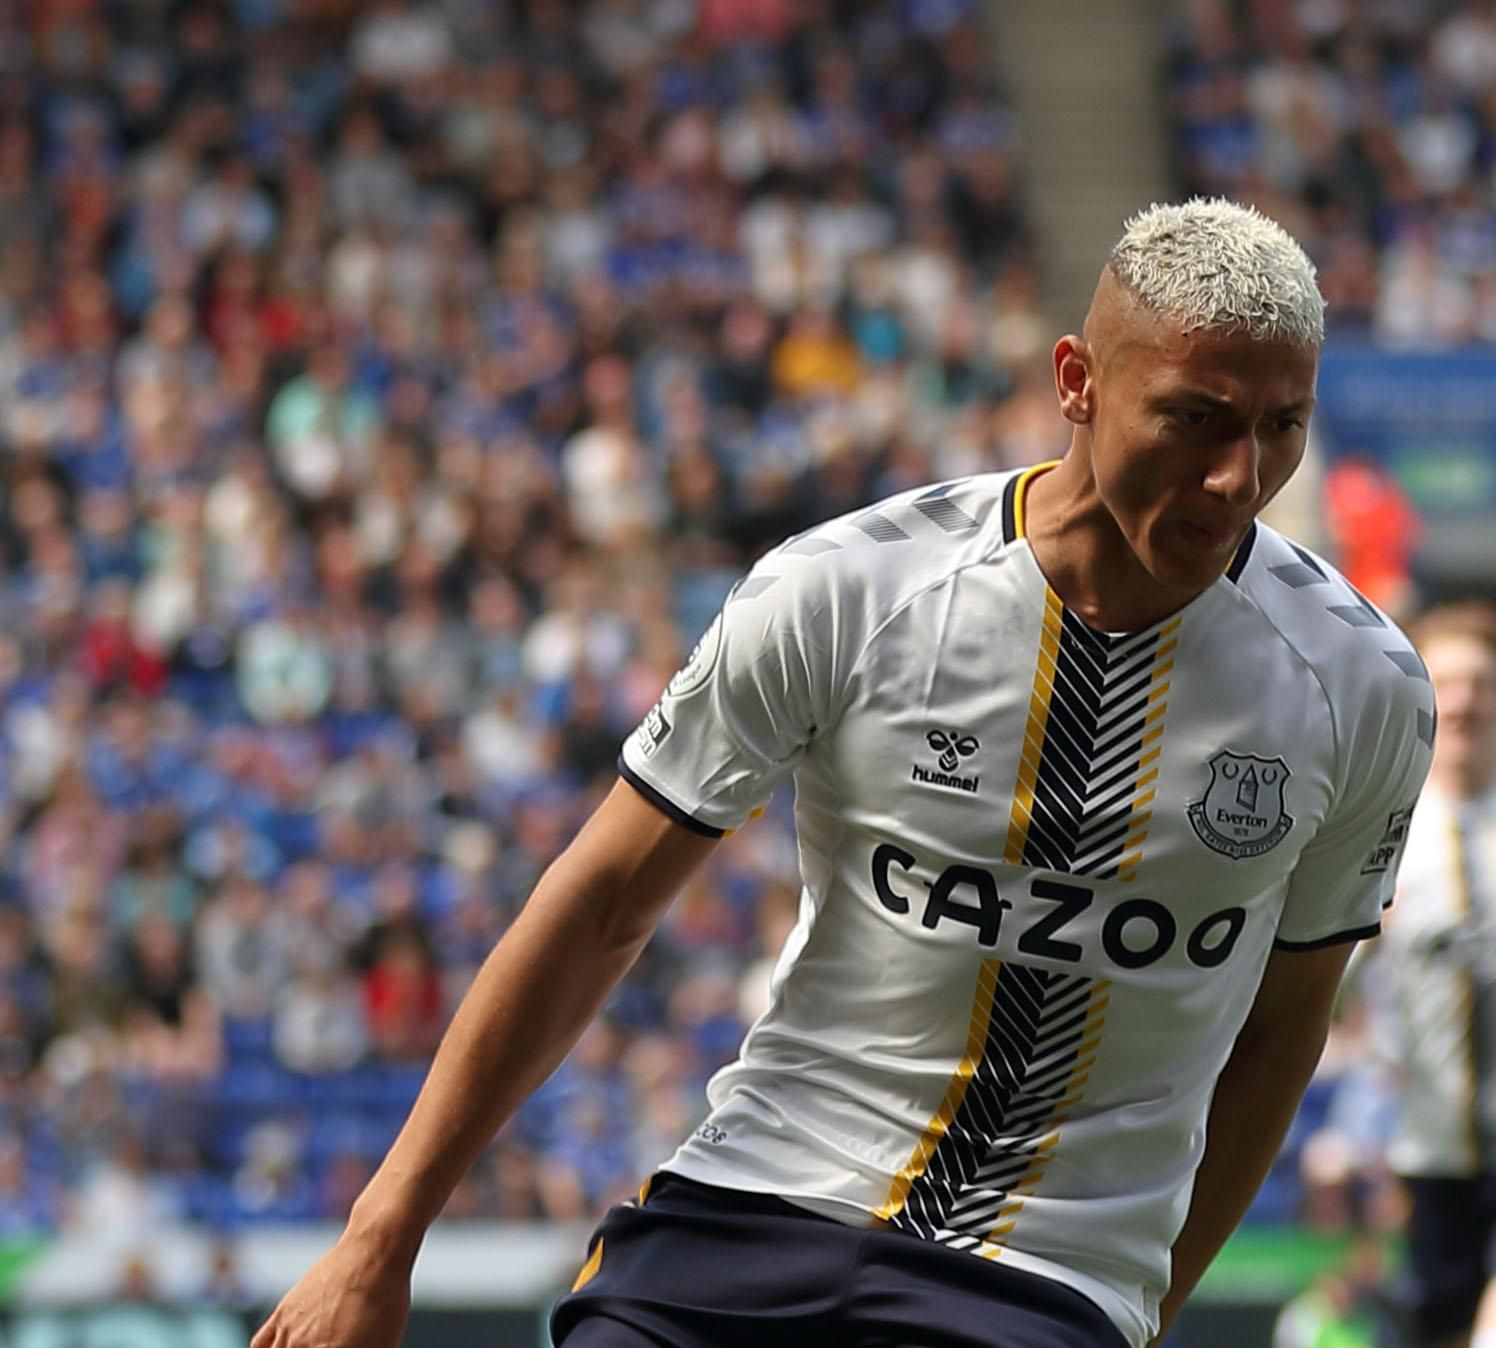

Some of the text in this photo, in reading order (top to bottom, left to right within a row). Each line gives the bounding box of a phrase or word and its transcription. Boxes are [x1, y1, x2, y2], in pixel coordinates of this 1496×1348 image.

[911, 764, 980, 793] hummel
[1216, 808, 1269, 828] Everton
[871, 843, 1247, 970] CAZOO
